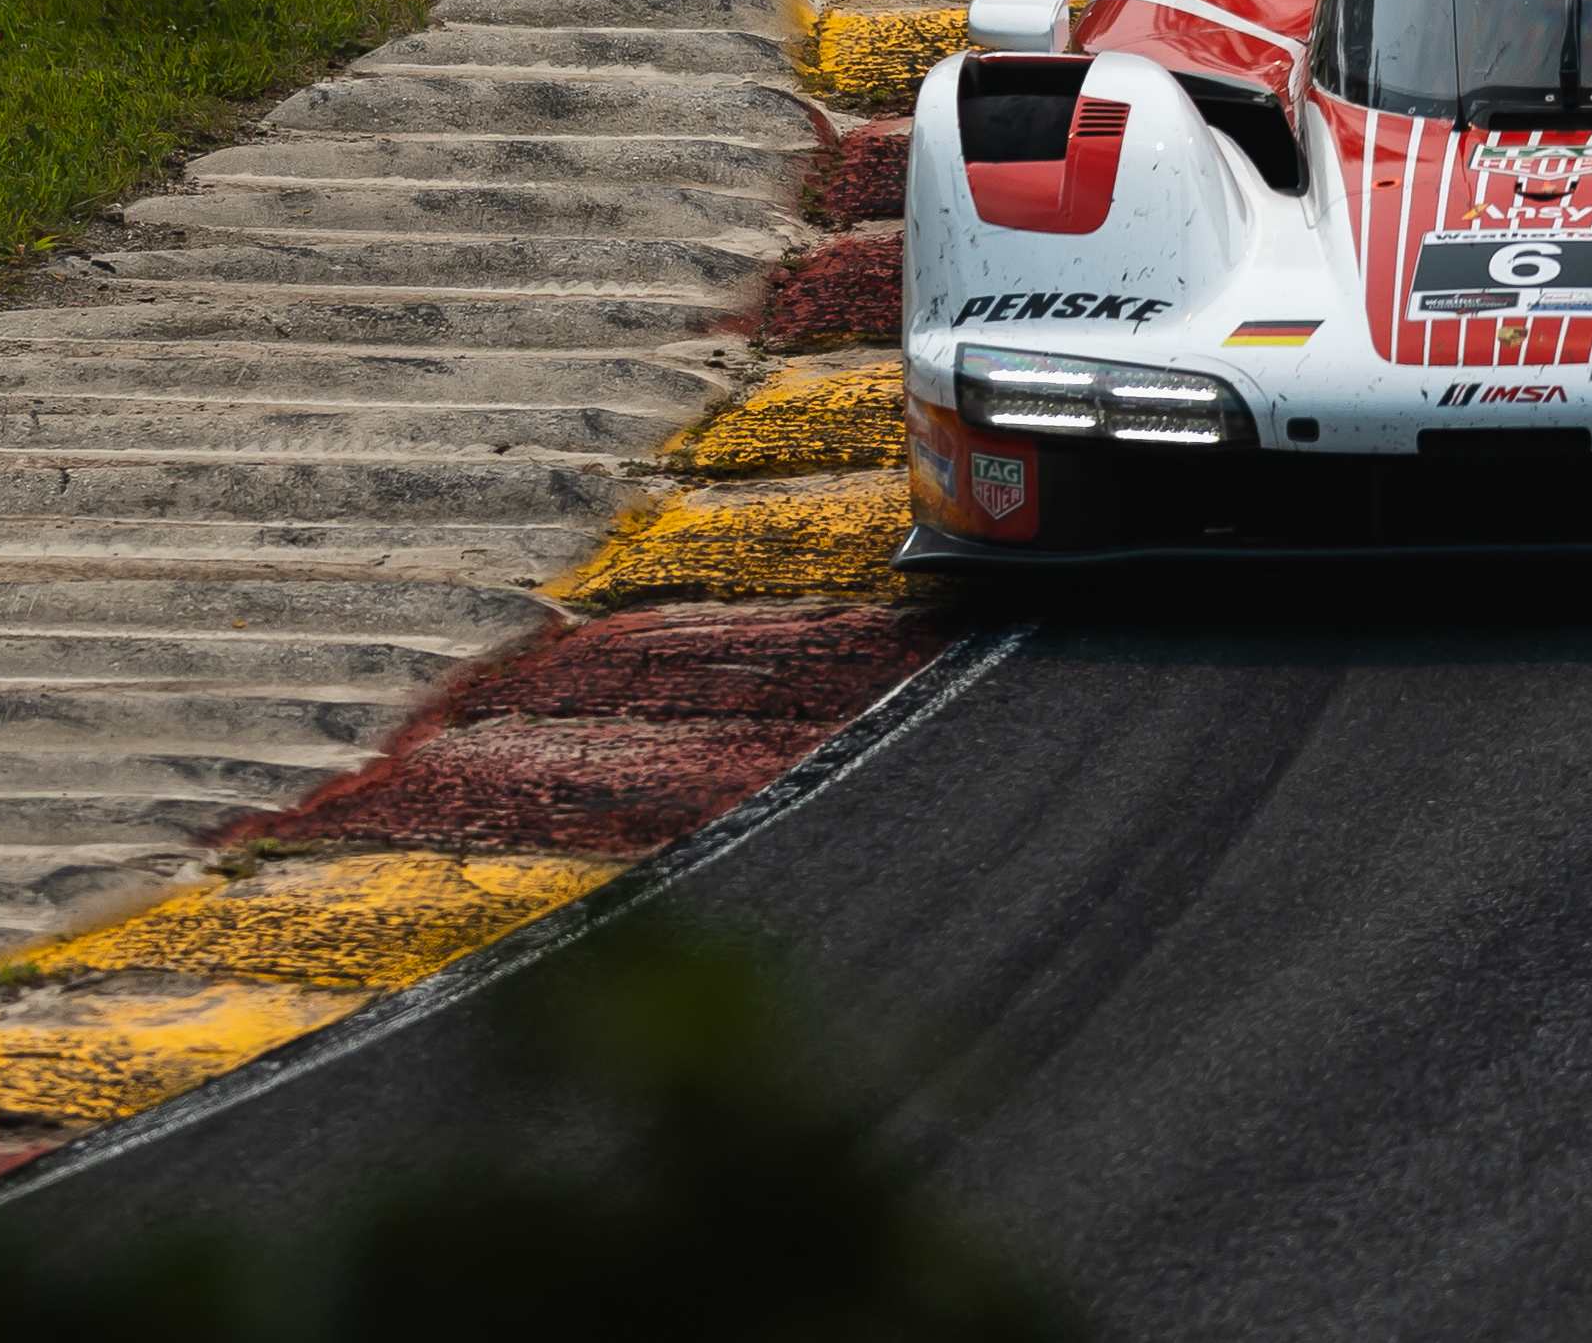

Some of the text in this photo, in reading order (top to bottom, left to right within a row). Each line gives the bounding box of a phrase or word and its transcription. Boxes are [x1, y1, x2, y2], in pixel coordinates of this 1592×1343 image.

[1489, 242, 1562, 286] 6
[953, 292, 1172, 327] PENSKE
[1480, 385, 1568, 403] IMSA
[975, 458, 1019, 483] TAG
[975, 482, 1020, 514] HEUER
